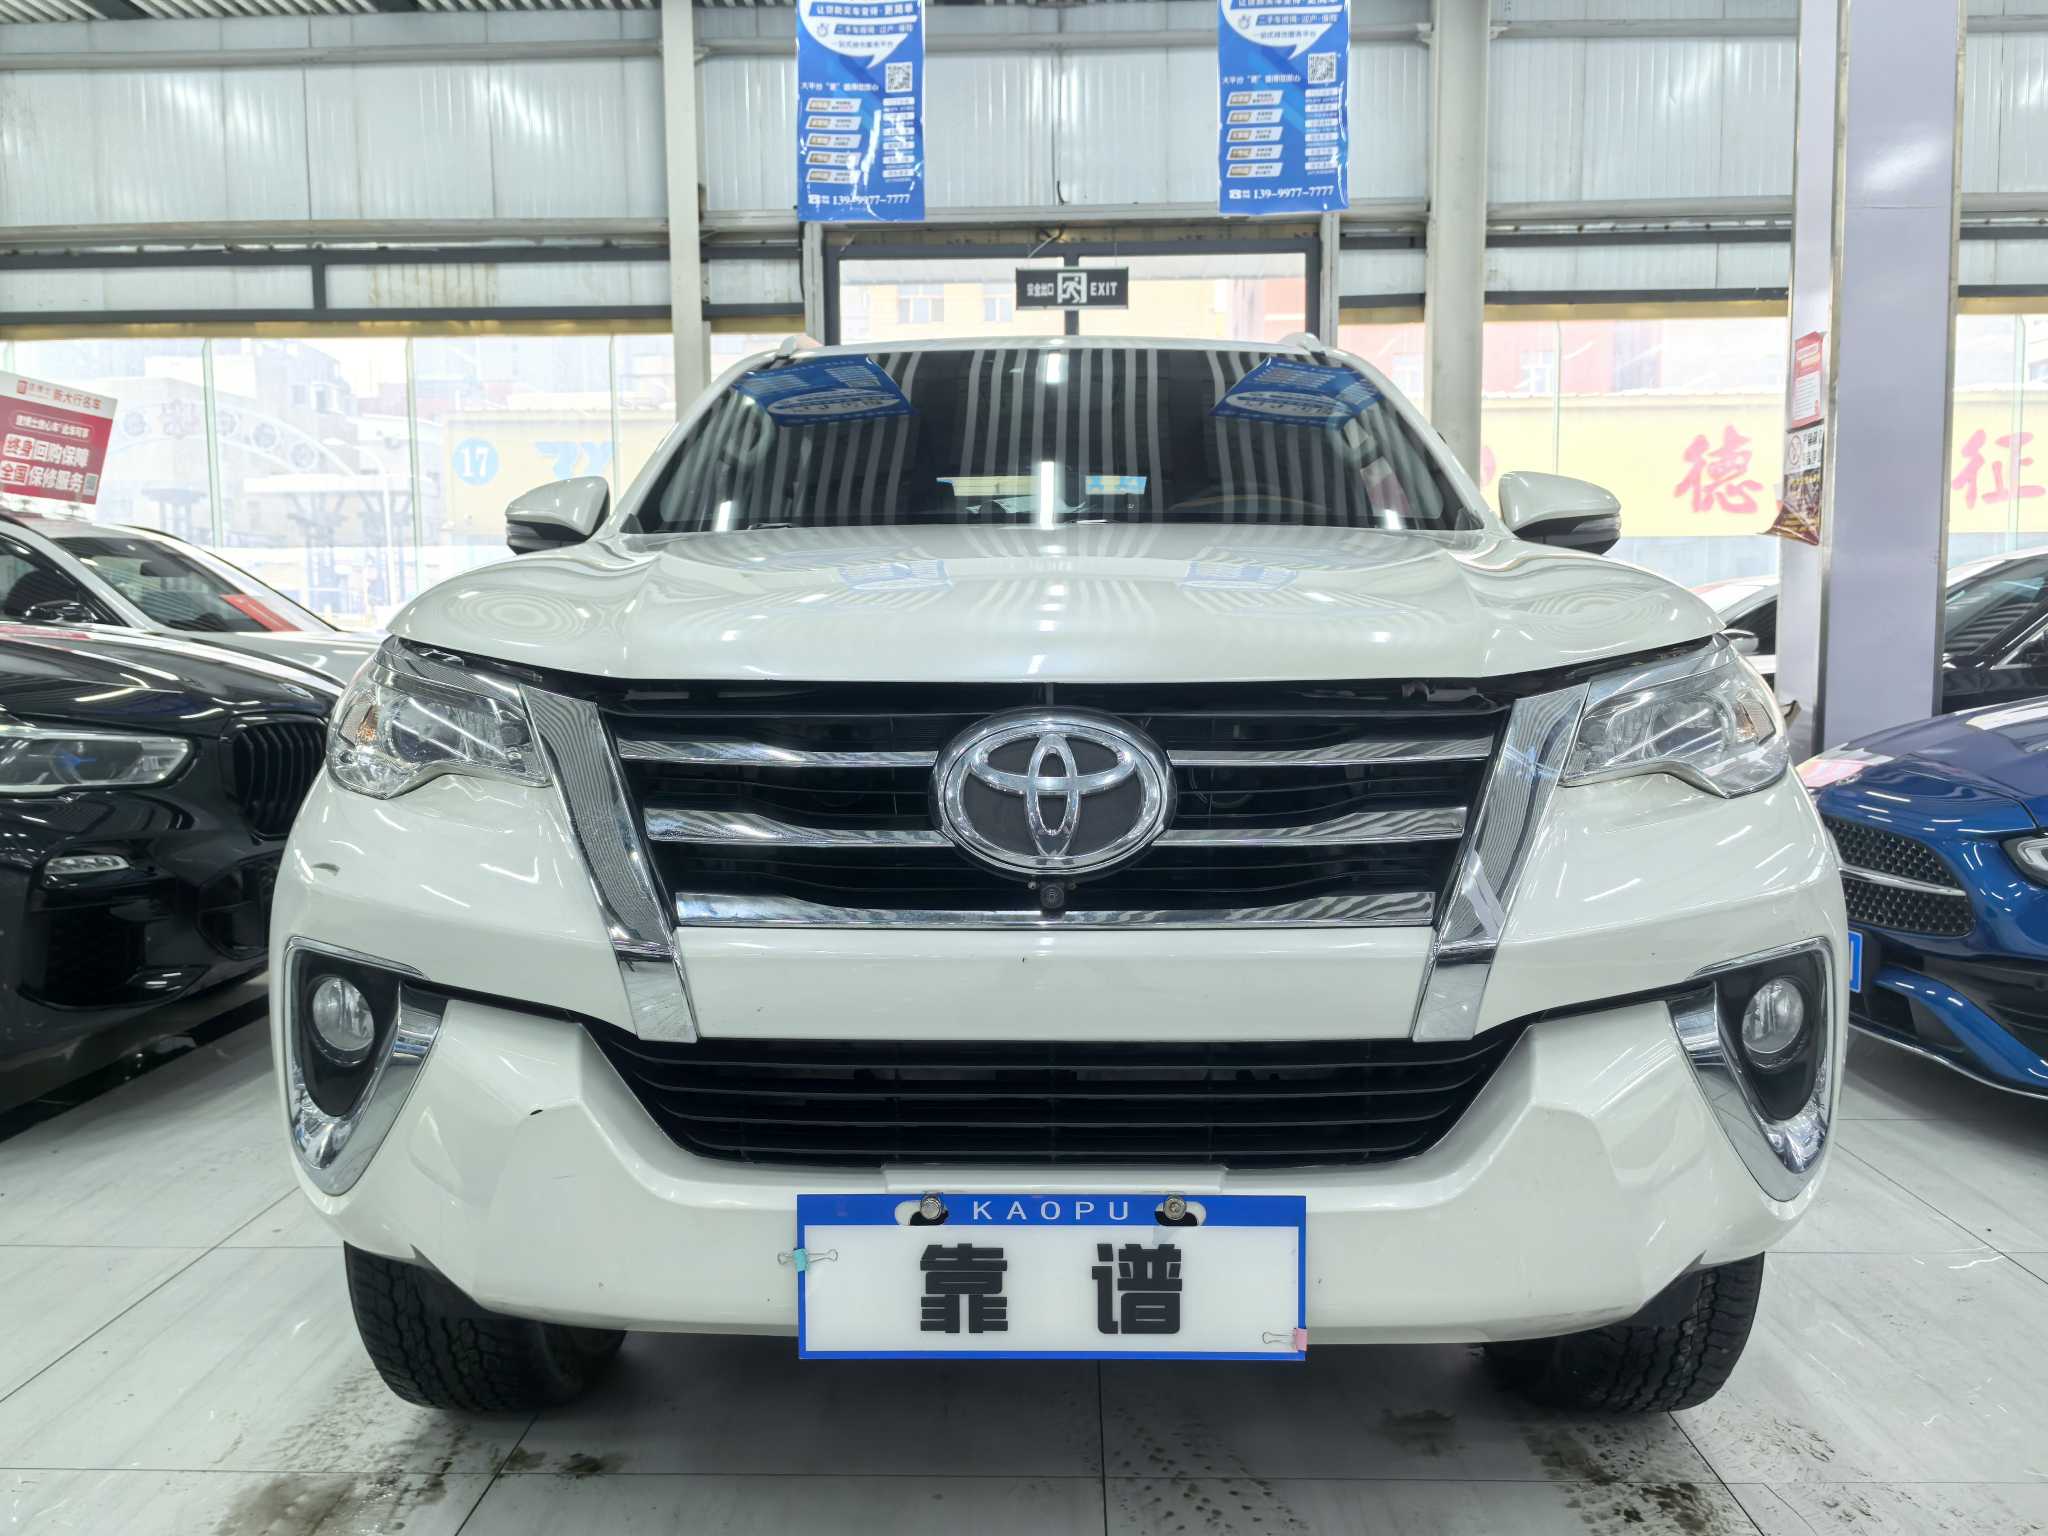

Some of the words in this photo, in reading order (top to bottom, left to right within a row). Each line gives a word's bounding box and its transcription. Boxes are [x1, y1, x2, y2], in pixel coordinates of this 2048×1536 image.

[1254, 186, 1334, 199] 139-9977-7777
[1026, 282, 1055, 297] 安全出口
[1090, 282, 1118, 297] EXIT
[5, 436, 90, 468] 终身回购保障
[462, 446, 489, 478] 17
[1, 462, 84, 493] 全国保修服务
[1675, 424, 1764, 514] 德
[1952, 429, 2047, 509] 征
[972, 1201, 1130, 1221] KAOPU
[920, 1243, 1183, 1335] 靠谱
